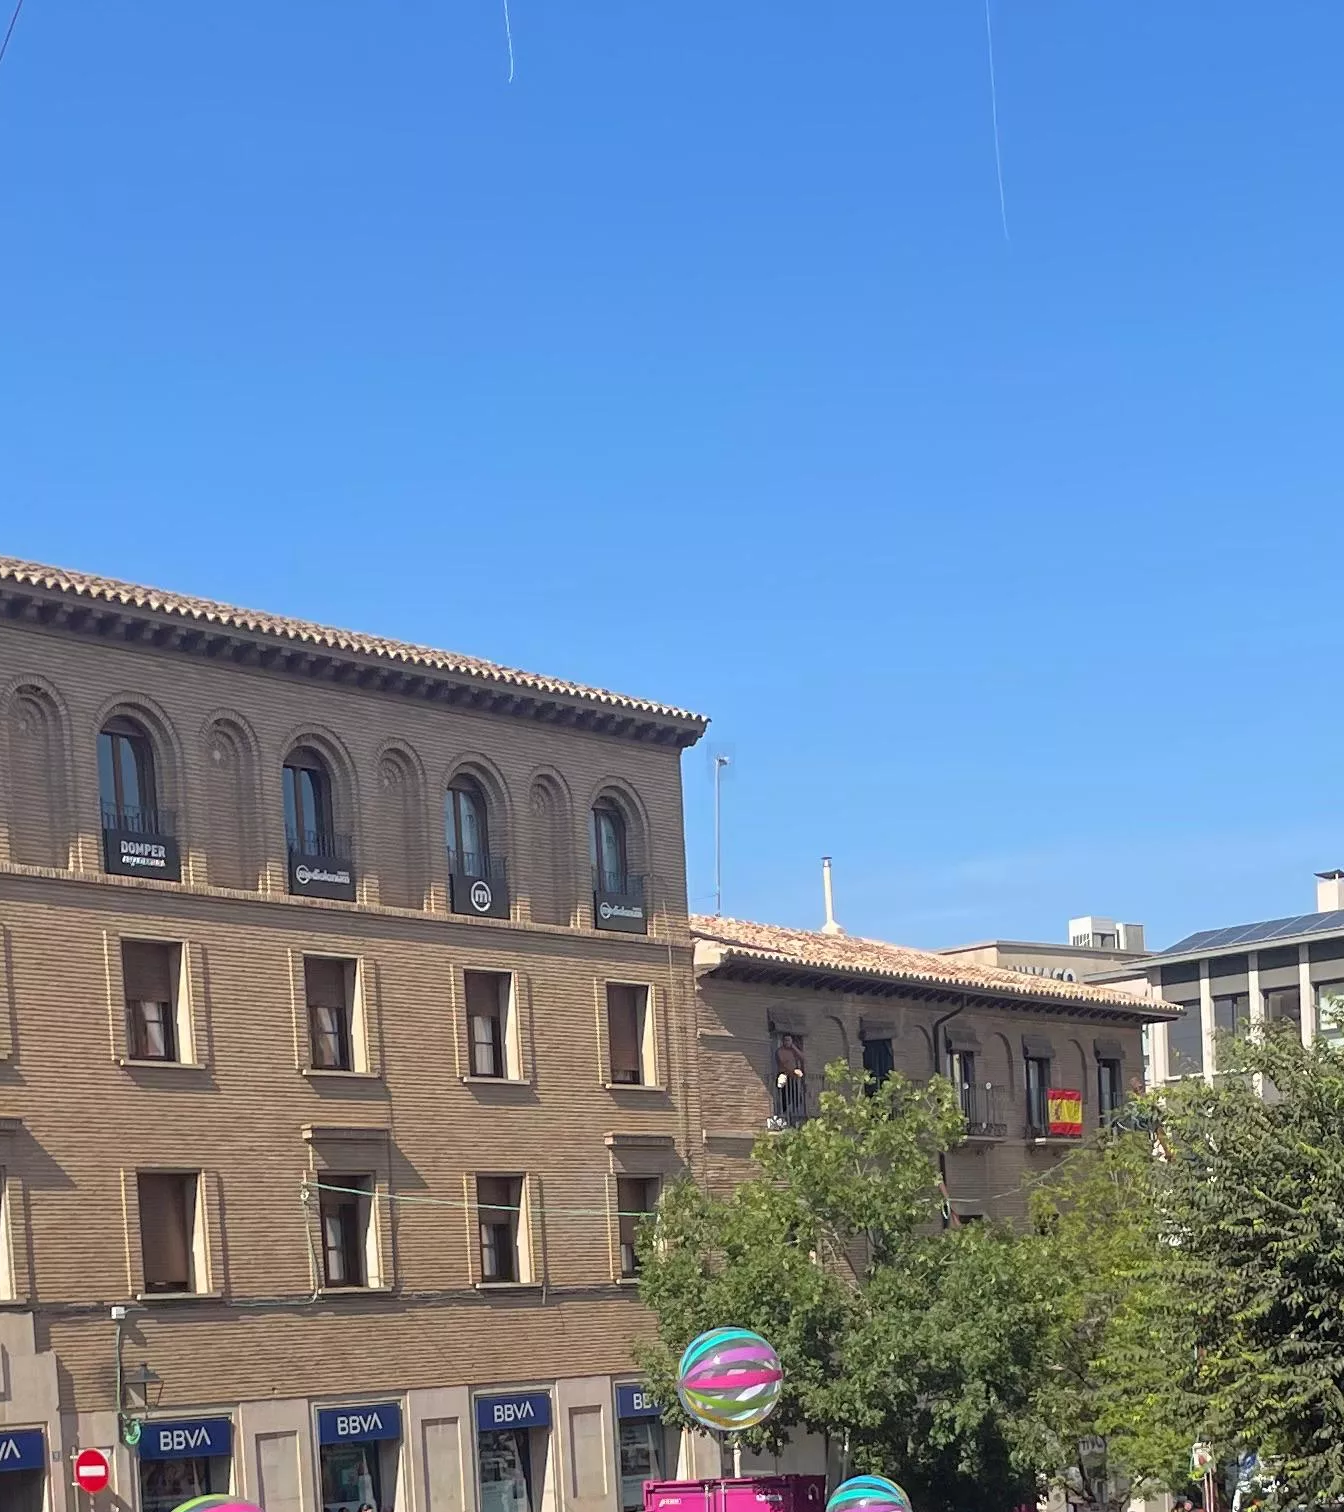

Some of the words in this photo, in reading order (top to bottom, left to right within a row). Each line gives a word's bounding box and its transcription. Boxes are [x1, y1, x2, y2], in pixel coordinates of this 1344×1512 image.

[120, 841, 166, 858] DOMPER
[494, 1401, 535, 1423] BBVA
[633, 1393, 659, 1410] BB
[337, 1412, 383, 1435] BBVA
[159, 1427, 211, 1451] BBVA
